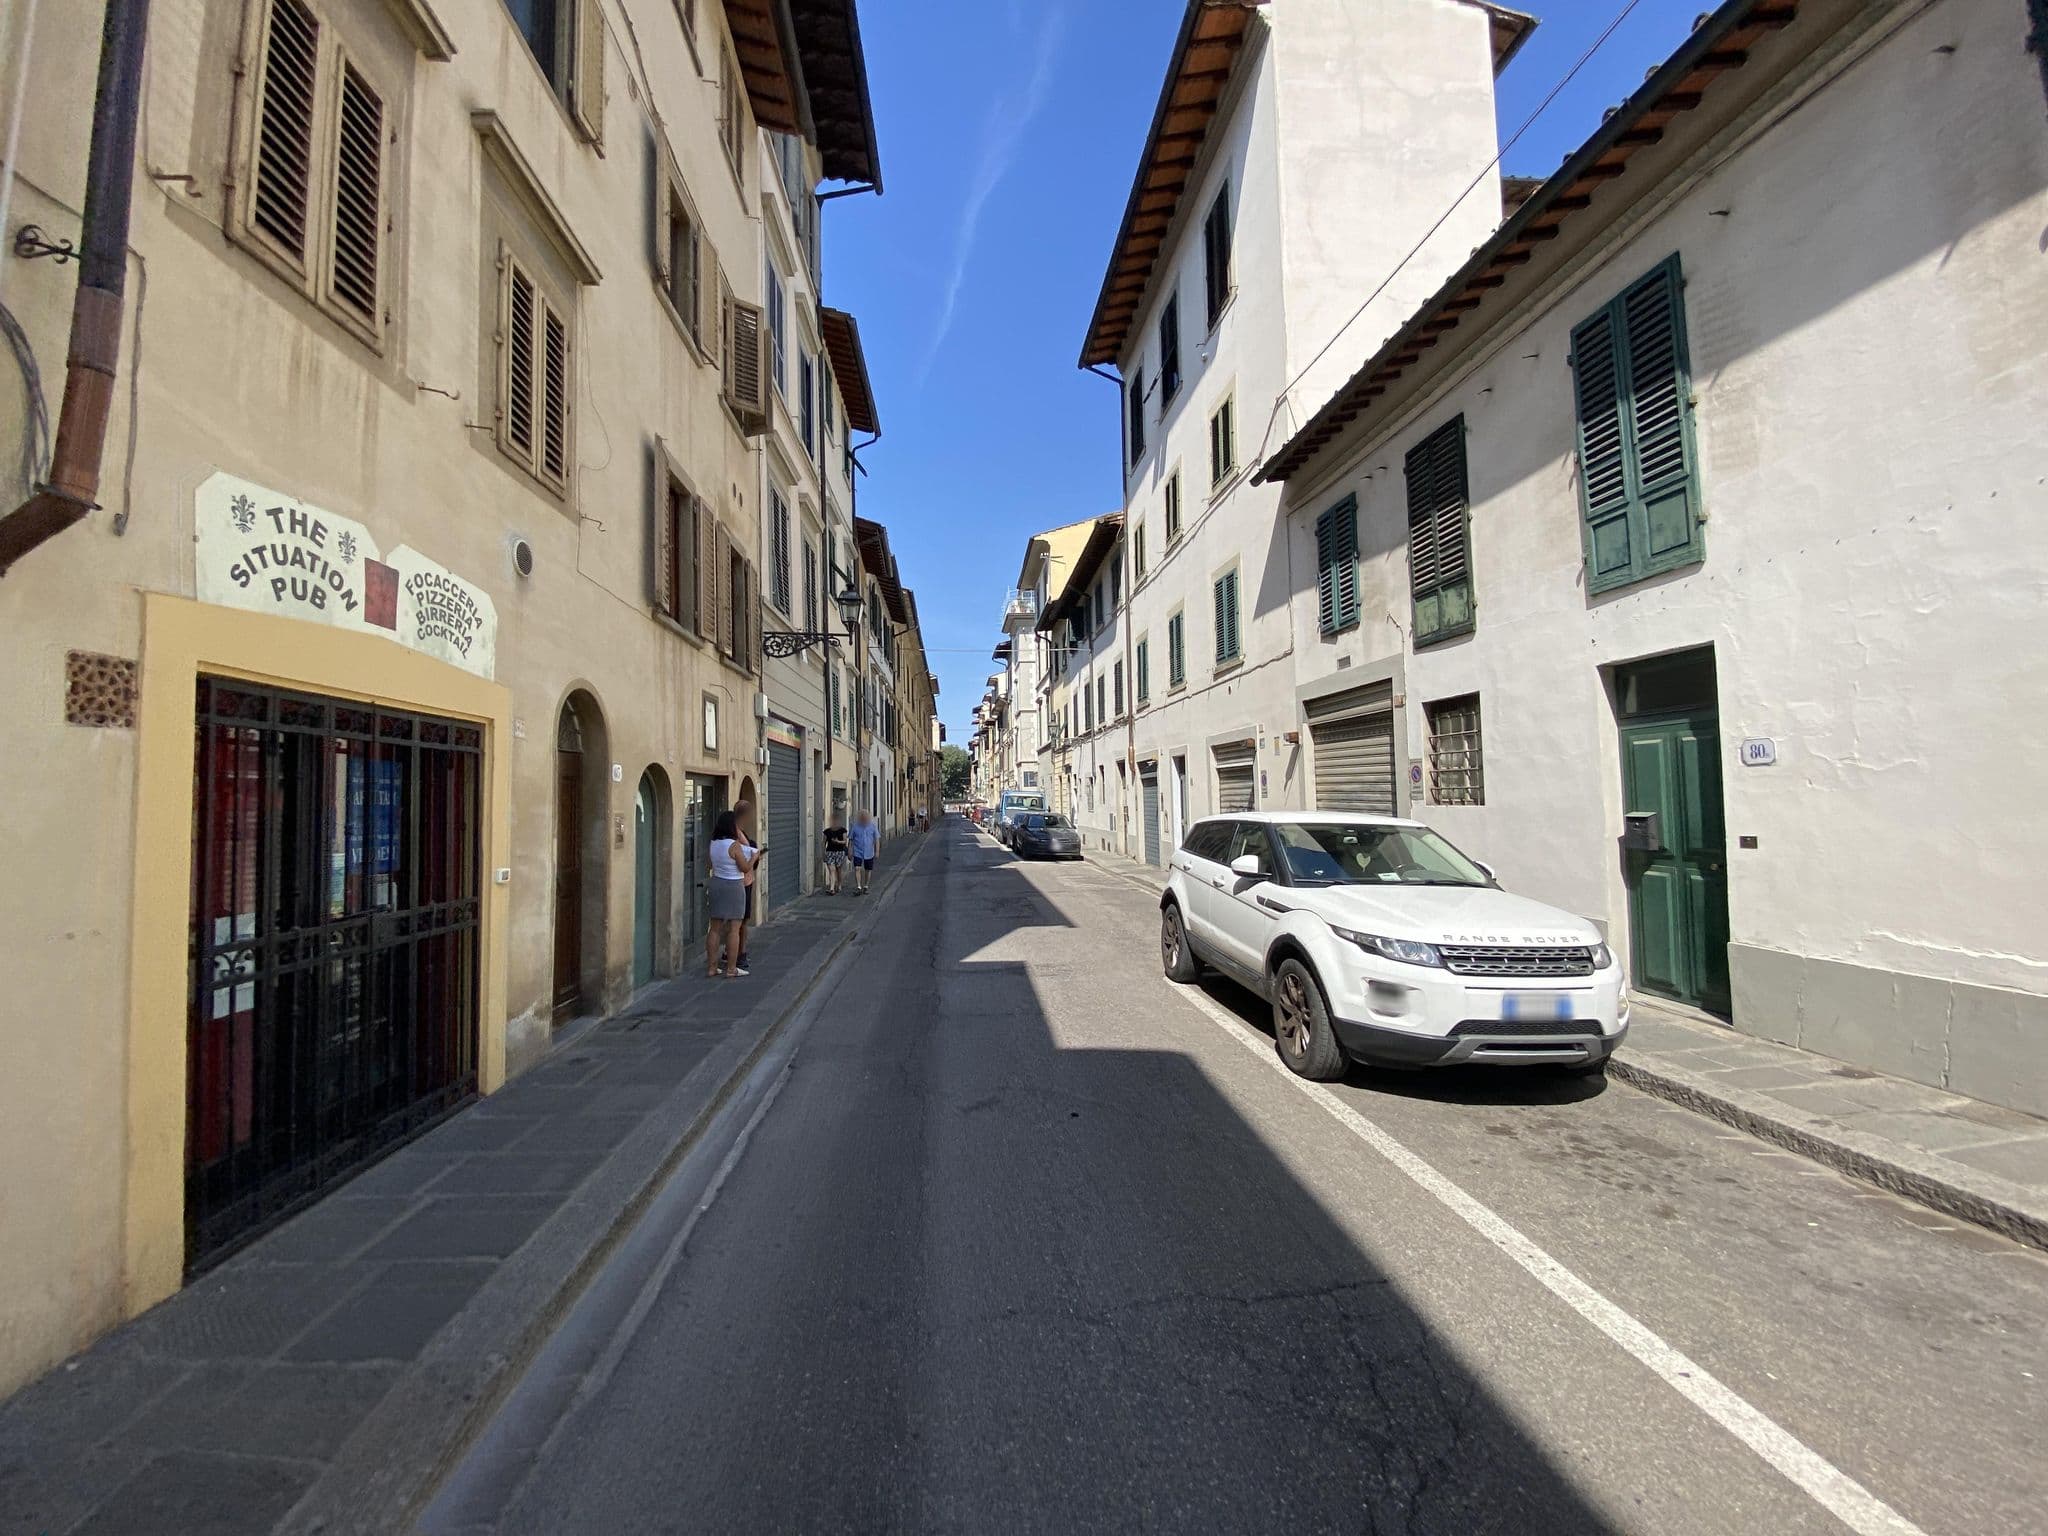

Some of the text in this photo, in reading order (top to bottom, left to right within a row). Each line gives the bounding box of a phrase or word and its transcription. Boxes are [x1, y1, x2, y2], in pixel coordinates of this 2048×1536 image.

[265, 506, 328, 549] THE
[230, 543, 359, 613] SITUATION
[270, 577, 328, 611] PUB
[404, 571, 484, 630] FOCACCERIA
[416, 591, 474, 630] PIZZERIA
[416, 609, 473, 649] BIRRERIA
[416, 623, 470, 660] COCKTAIL
[1443, 934, 1510, 943] RANGE
